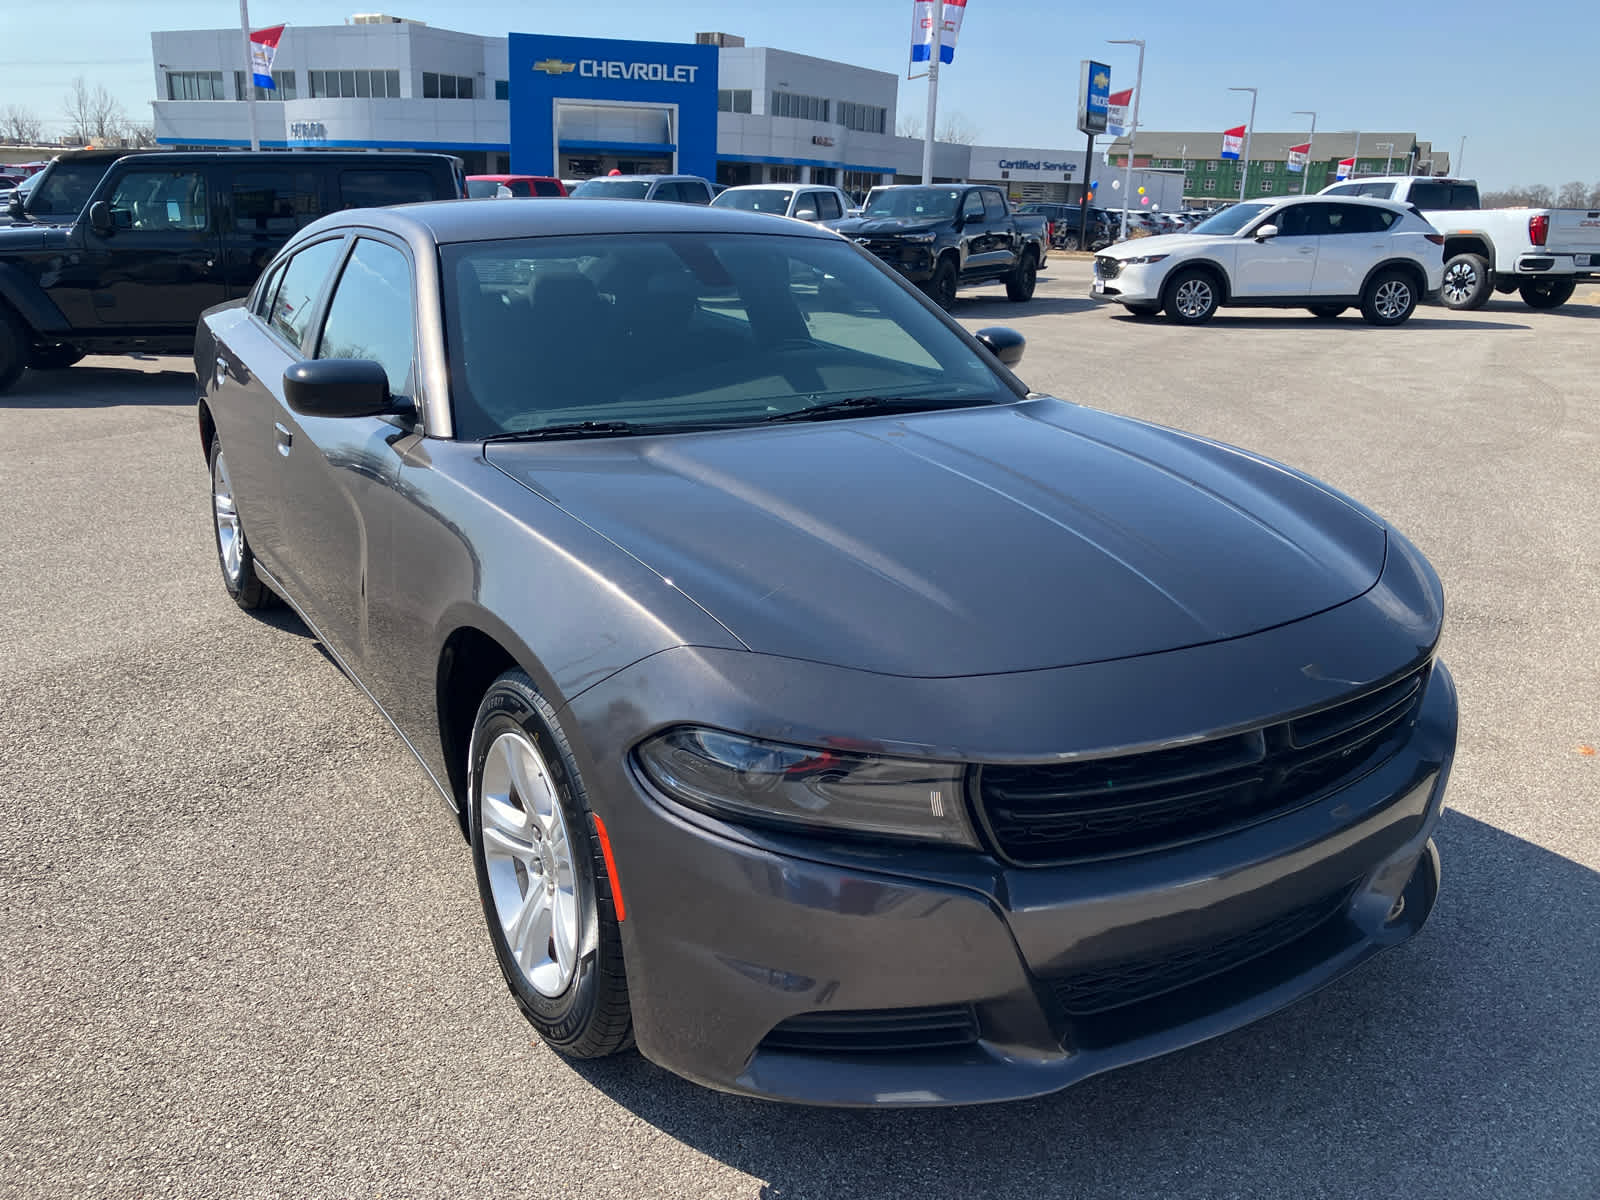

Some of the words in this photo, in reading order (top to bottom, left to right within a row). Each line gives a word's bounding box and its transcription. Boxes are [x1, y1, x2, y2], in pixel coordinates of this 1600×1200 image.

[920, 18, 955, 32] GC
[579, 59, 698, 83] CHEVROLET
[999, 159, 1040, 170] Certified
[1042, 161, 1077, 171] Service
